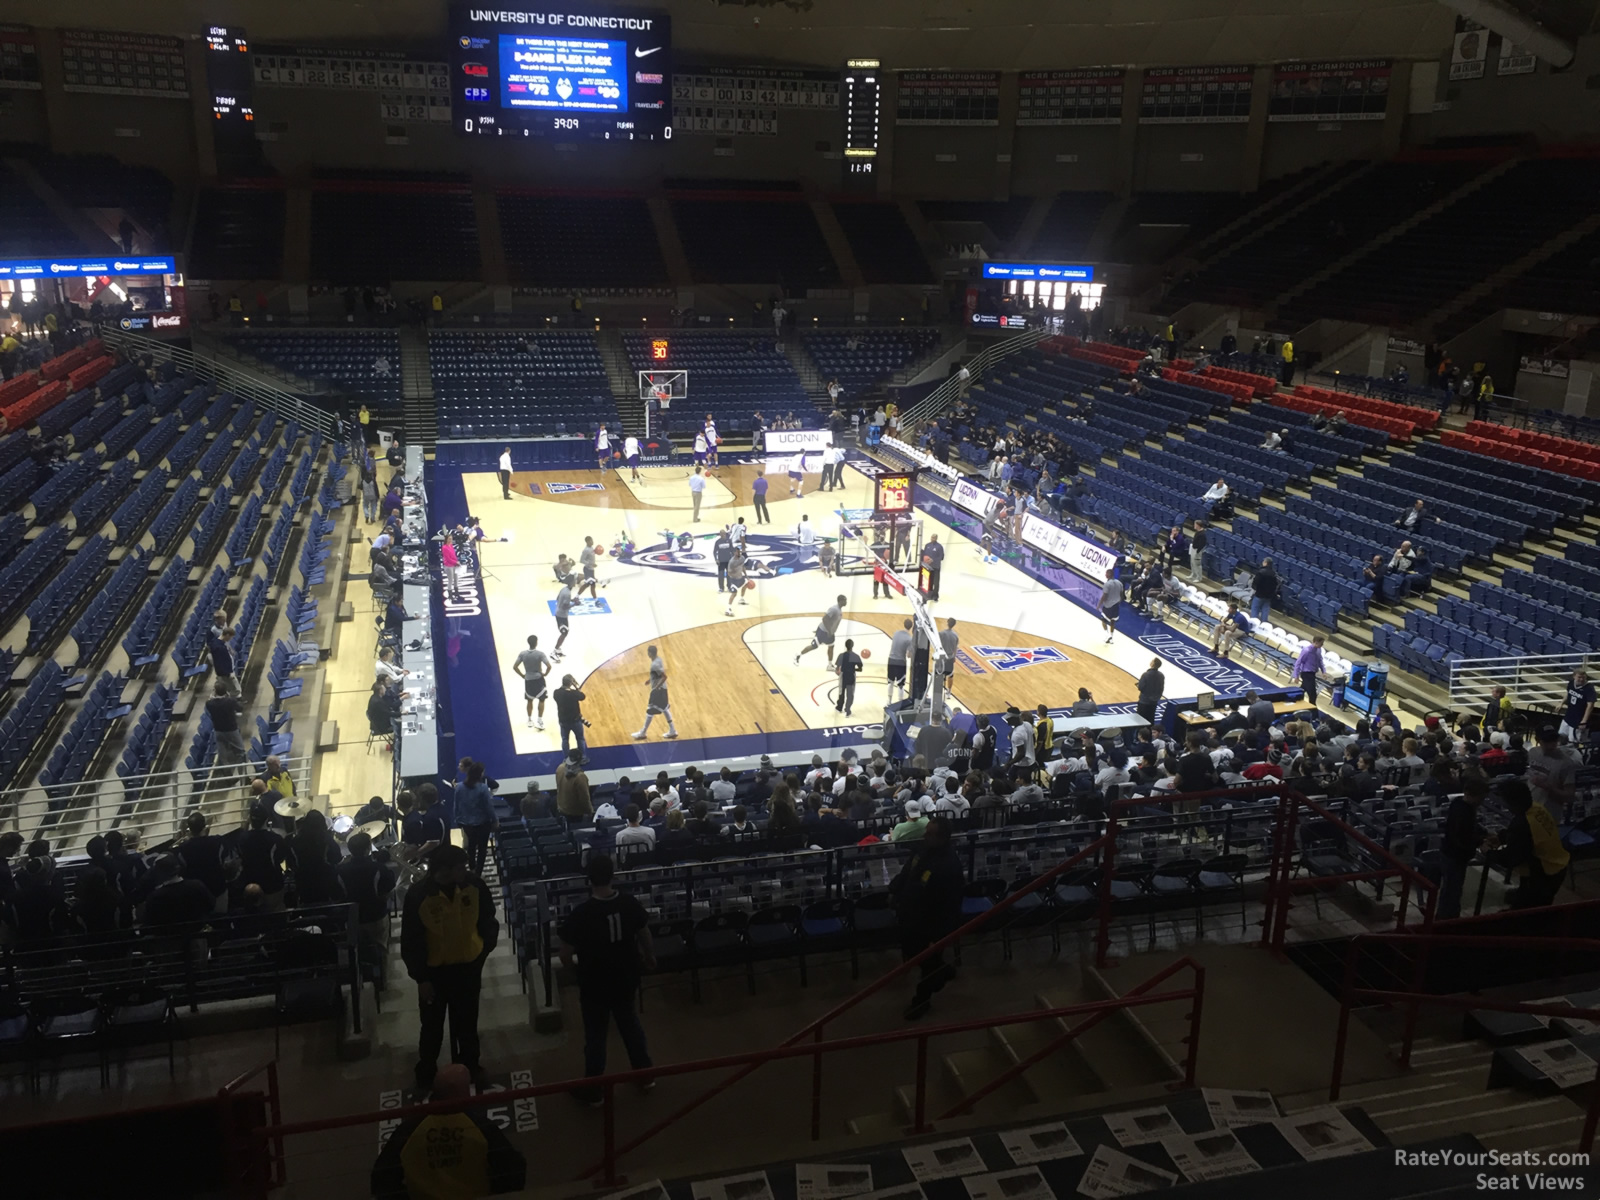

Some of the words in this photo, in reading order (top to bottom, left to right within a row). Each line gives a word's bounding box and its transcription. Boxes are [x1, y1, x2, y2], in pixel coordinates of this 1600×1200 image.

[470, 10, 545, 24] UNIVERSITY
[548, 14, 564, 24] OF
[567, 15, 652, 30] CONNECTICUT
[584, 56, 612, 66] PACK
[1311, 61, 1386, 70] CHAMPIONSHIP
[308, 71, 325, 83] 22
[1178, 67, 1248, 75] CHAMPIONSHIP
[333, 72, 350, 84] 25
[358, 74, 375, 85] 42
[383, 74, 399, 86] 44
[431, 77, 447, 88] 42
[676, 88, 689, 98] 52
[719, 90, 732, 100] 00
[741, 91, 753, 101] 13
[761, 92, 775, 102] 42
[386, 106, 400, 117] 13
[408, 107, 424, 118] 22
[465, 119, 473, 132] 0
[554, 118, 579, 130] 39:09
[664, 126, 672, 139] 0
[851, 164, 872, 173] 11:19
[654, 348, 666, 358] 30
[779, 434, 820, 443] UCONN
[959, 484, 978, 500] UCONN
[1029, 524, 1067, 552] HEALTH
[1081, 545, 1110, 568] UCONN
[955, 648, 987, 674] MERICAN
[1138, 634, 1263, 694] UCONN
[606, 912, 622, 943] 11
[426, 1127, 464, 1142] CSC
[426, 1144, 463, 1157] EVENT
[428, 1157, 463, 1169] STAFF
